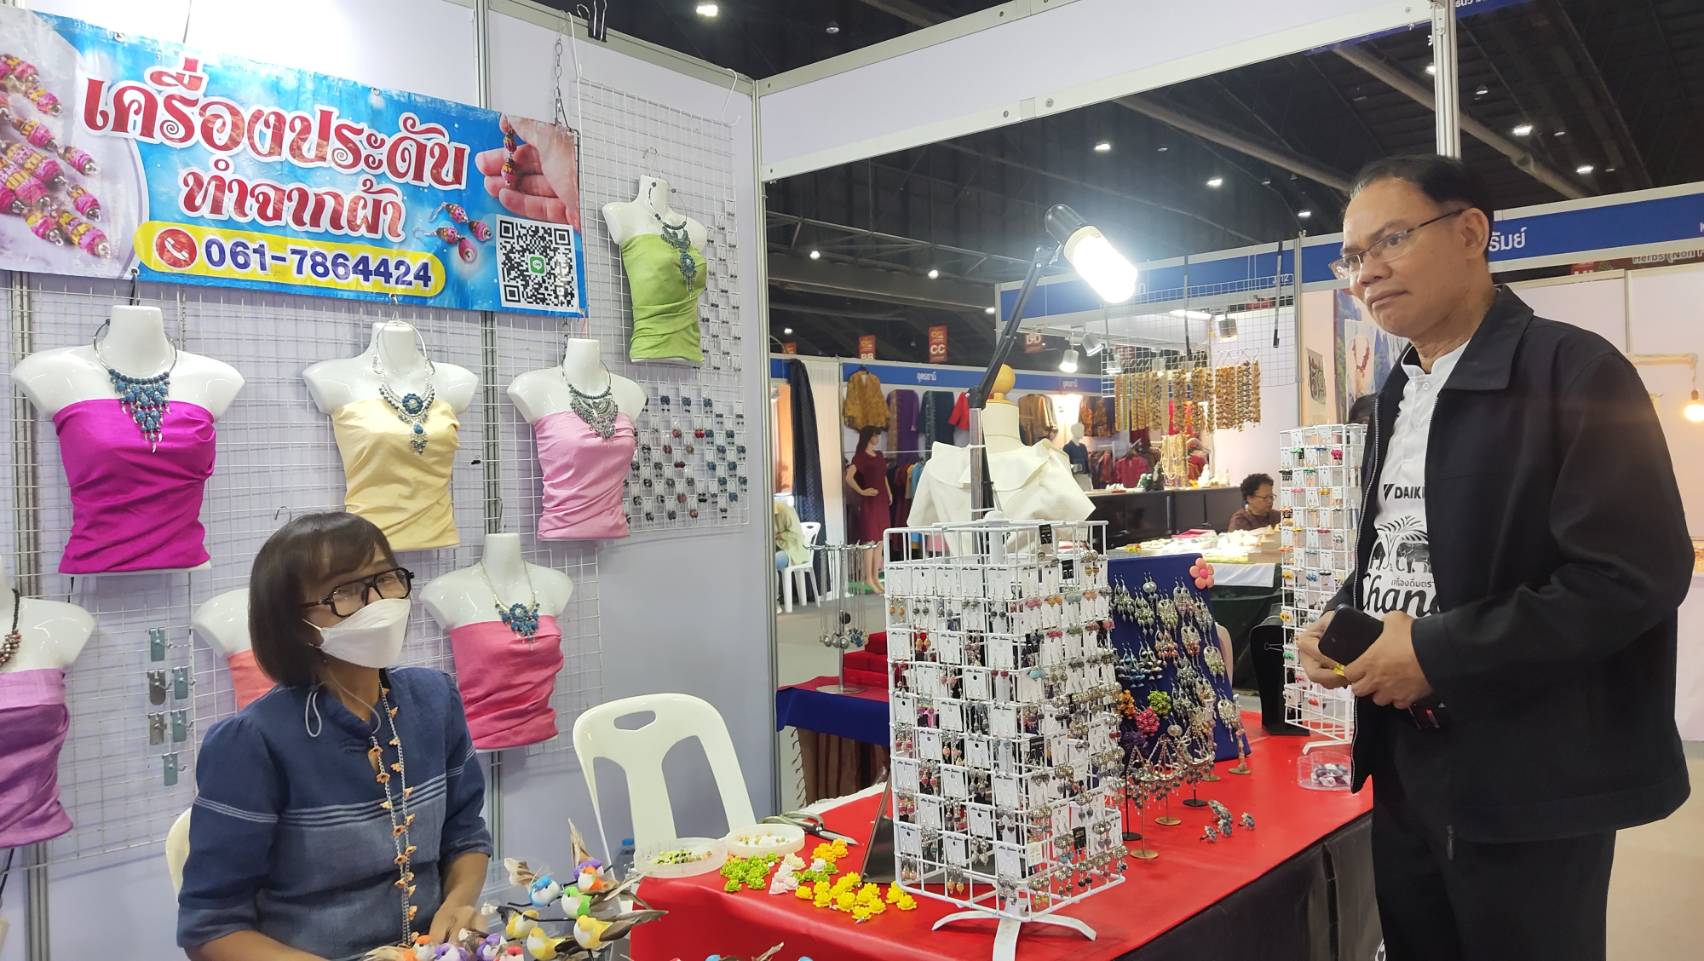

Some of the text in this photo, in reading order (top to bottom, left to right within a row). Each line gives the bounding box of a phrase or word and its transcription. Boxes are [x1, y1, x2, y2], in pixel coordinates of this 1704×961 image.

[84, 57, 467, 187] เครื่องประดับ
[182, 158, 403, 238] ทำจากผ้า
[205, 237, 432, 288] 061-7864424
[930, 344, 945, 354] CC
